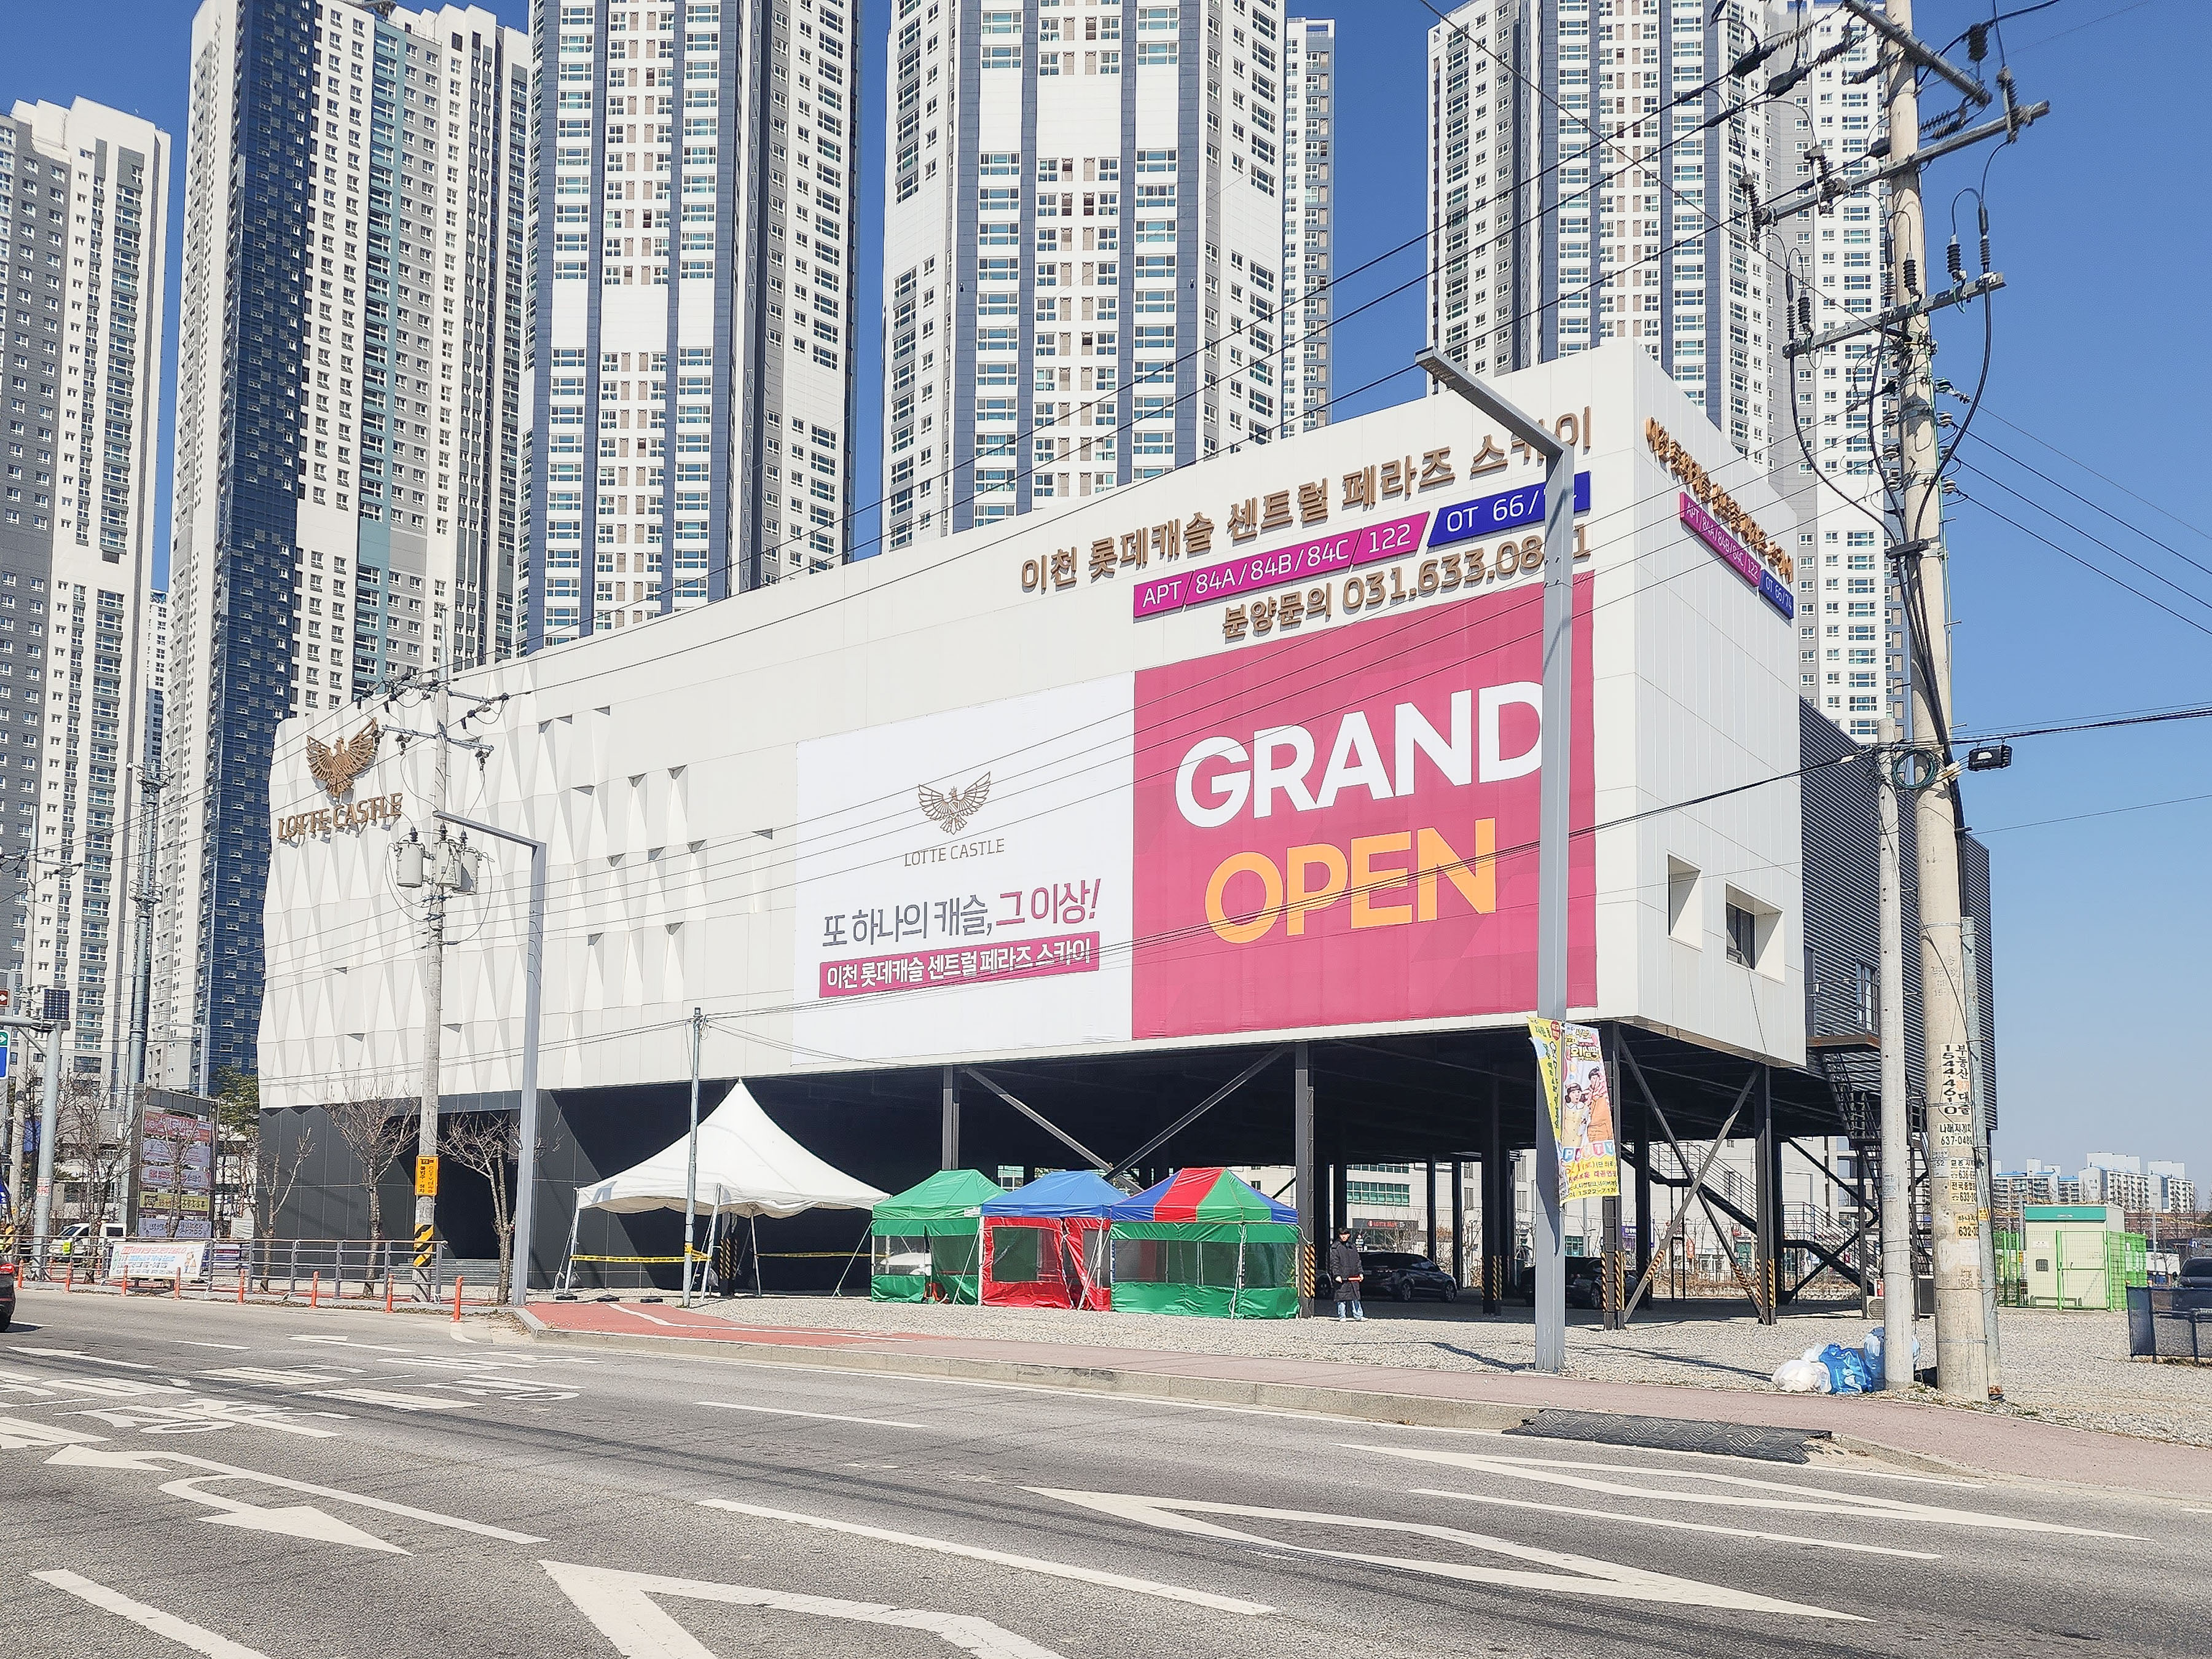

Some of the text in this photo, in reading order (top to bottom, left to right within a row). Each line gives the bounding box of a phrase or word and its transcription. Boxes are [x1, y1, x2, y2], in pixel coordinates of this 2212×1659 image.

[1021, 544, 1078, 592] 이천
[1088, 511, 1215, 579] 롯데캐슬
[1227, 477, 1330, 541] 센트럴
[1342, 446, 1455, 509] 페라즈
[1142, 489, 1577, 608] APT 84A/84B/84C 122 OT 66/
[1687, 502, 1700, 524] APT
[1747, 558, 1759, 580] 122
[1765, 576, 1773, 593] OT
[1222, 524, 1591, 640] 분양문의 031.633.081
[1175, 680, 1543, 828] GRAND
[277, 792, 403, 840] LOTTE CASTLE
[904, 838, 1005, 866] LOTTE CASTLE
[822, 915, 847, 947] 또
[852, 901, 928, 945] 하나의
[933, 894, 992, 936] 캐슬,
[1204, 817, 1496, 944] OPEN
[826, 938, 1091, 989] 이천 롯데캐슬 센트럴 페라즈 스카이
[1955, 1044, 1969, 1080] 부동산
